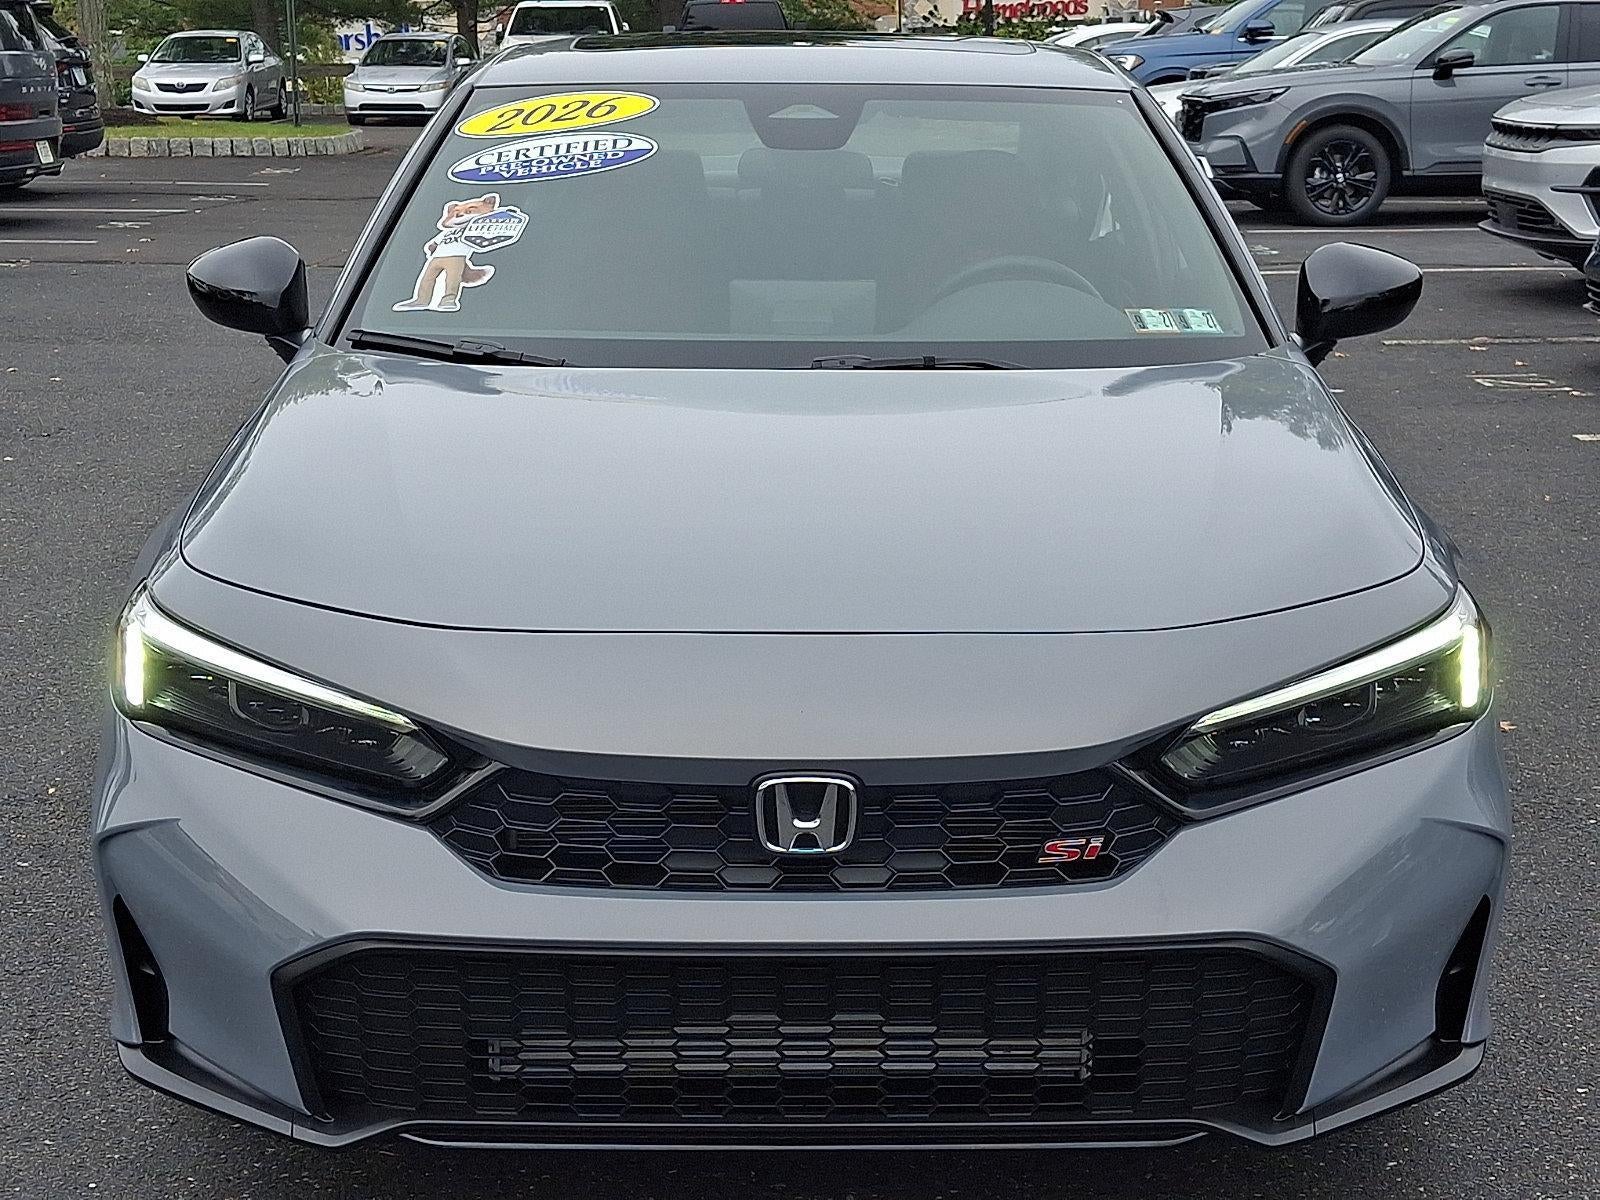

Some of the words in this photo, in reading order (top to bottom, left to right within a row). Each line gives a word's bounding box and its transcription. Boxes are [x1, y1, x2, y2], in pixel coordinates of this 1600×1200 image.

[485, 96, 628, 133] 2026
[475, 138, 633, 166] CERTIFIED
[478, 151, 626, 175] PRE-OWNED
[498, 159, 603, 179] VEHICLE
[468, 224, 520, 232] LIFETIME
[1038, 836, 1105, 864] Si
